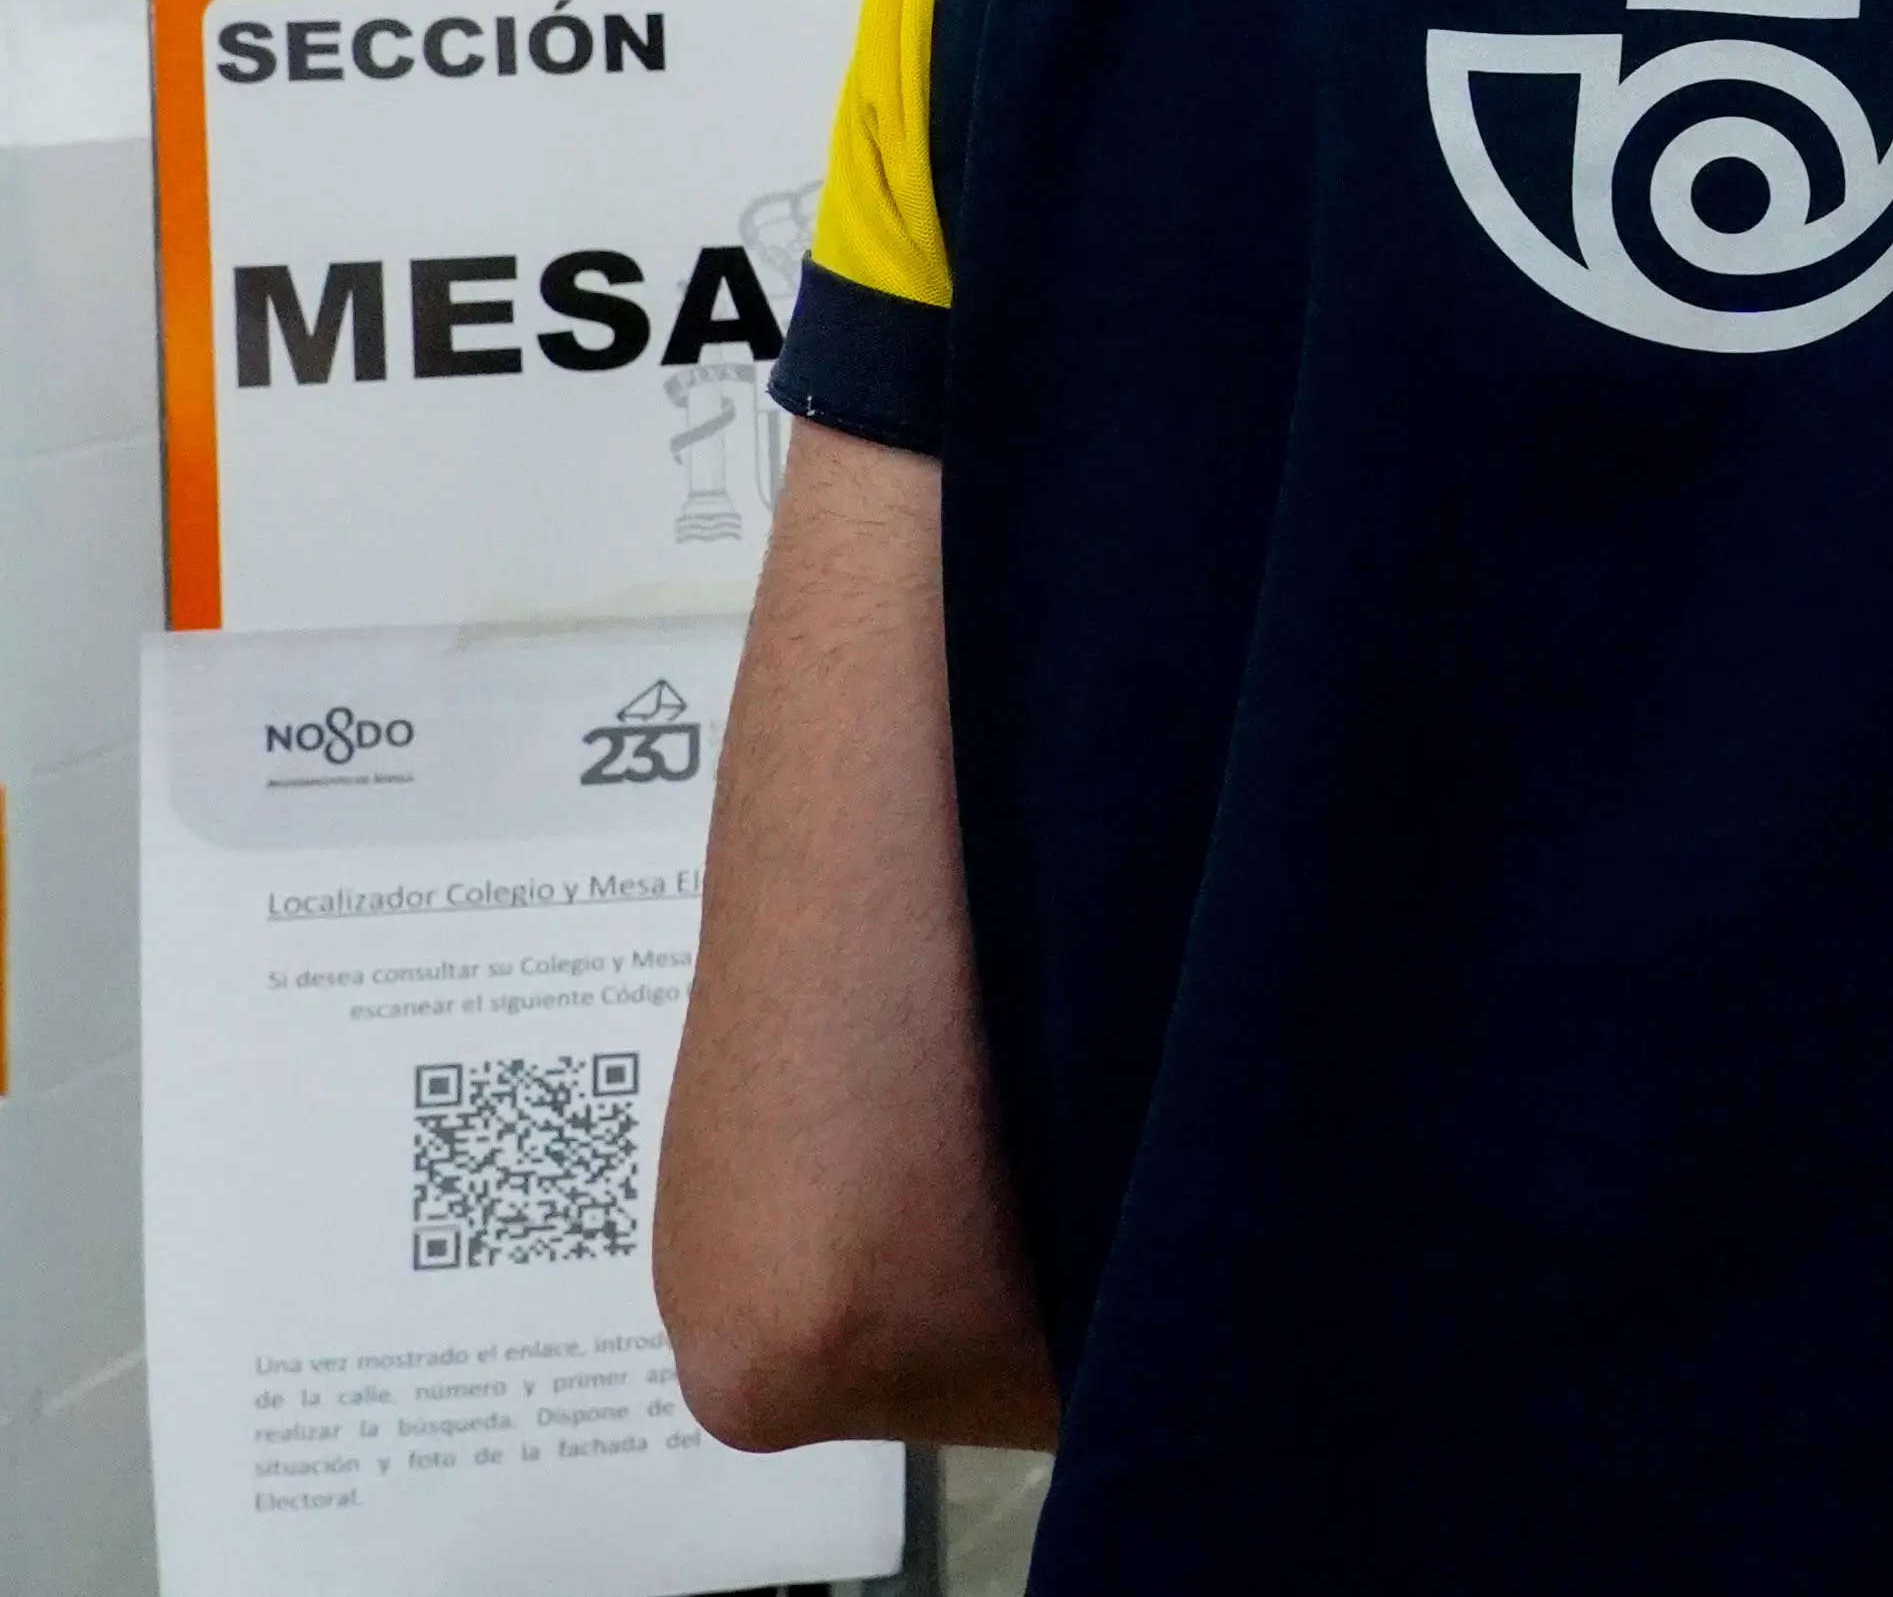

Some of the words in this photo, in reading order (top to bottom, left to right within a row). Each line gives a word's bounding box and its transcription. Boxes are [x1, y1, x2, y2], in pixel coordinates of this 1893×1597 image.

[217, 0, 665, 83] SECCIÓN
[234, 245, 787, 388] MESA
[268, 886, 437, 916] Localizador
[447, 878, 555, 907] Colegio
[563, 881, 579, 903] y
[589, 874, 667, 898] Mesa
[677, 870, 700, 893] El
[268, 970, 288, 990] Si
[296, 968, 364, 988] desea
[372, 960, 480, 984] consultar
[488, 961, 514, 977] su
[520, 953, 606, 977] Colegio
[612, 955, 625, 973] y
[632, 949, 692, 968] Mesa
[350, 999, 454, 1021] escanear
[461, 993, 483, 1014] el
[490, 990, 595, 1015] siguiente
[600, 982, 680, 1007] Código
[357, 1348, 469, 1371] mostrado
[594, 1332, 667, 1356] introd
